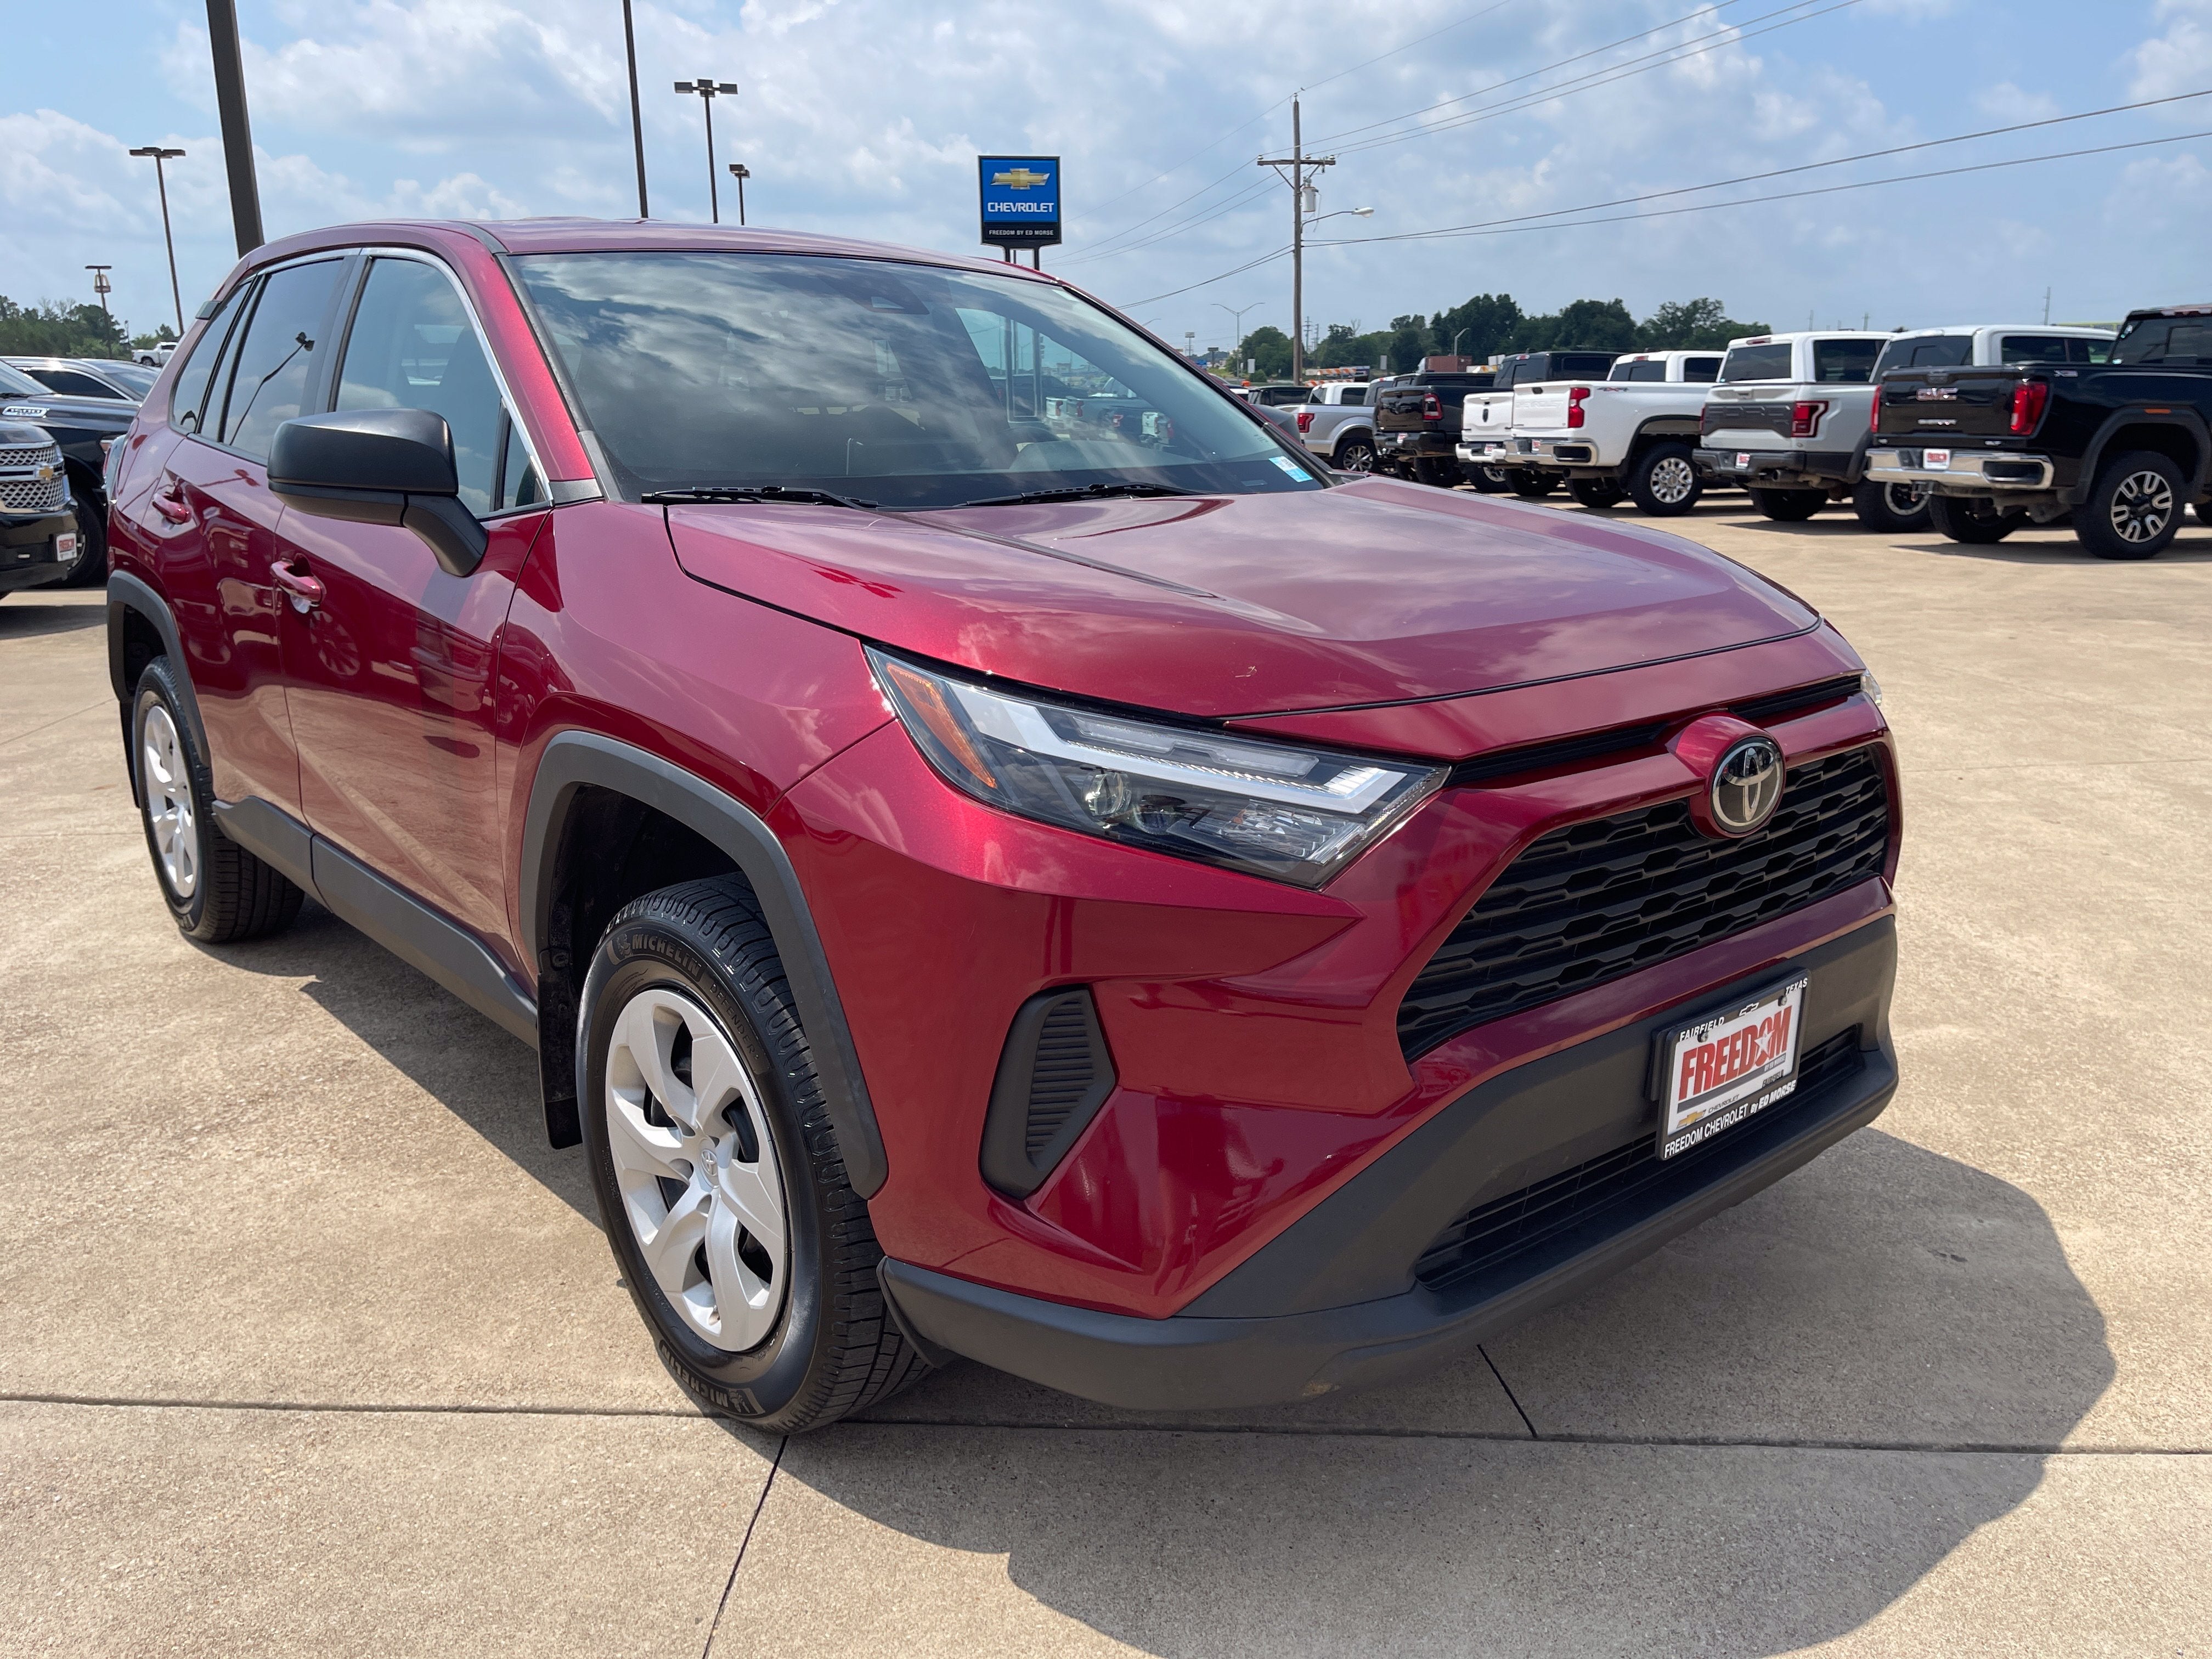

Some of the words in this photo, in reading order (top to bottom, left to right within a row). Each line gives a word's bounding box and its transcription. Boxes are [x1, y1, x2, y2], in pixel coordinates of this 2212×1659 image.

[988, 202, 1054, 212] CHEVROLET
[1707, 404, 1791, 416] FORD
[1916, 387, 1959, 400] GMC
[632, 934, 702, 977] MICHELIN
[1680, 1017, 1724, 1042] FAIRFIELD
[1785, 978, 1808, 996] TEXAS
[1678, 1006, 1792, 1101] FREEDOM
[1664, 1128, 1703, 1159] FREEDOM
[1704, 1103, 1749, 1138] CHEVROLET
[1758, 1094, 1770, 1110] ED
[1769, 1079, 1797, 1104] MORSE
[1708, 1094, 1740, 1114] CHEVROLET
[661, 1345, 729, 1408] MICHELIN
